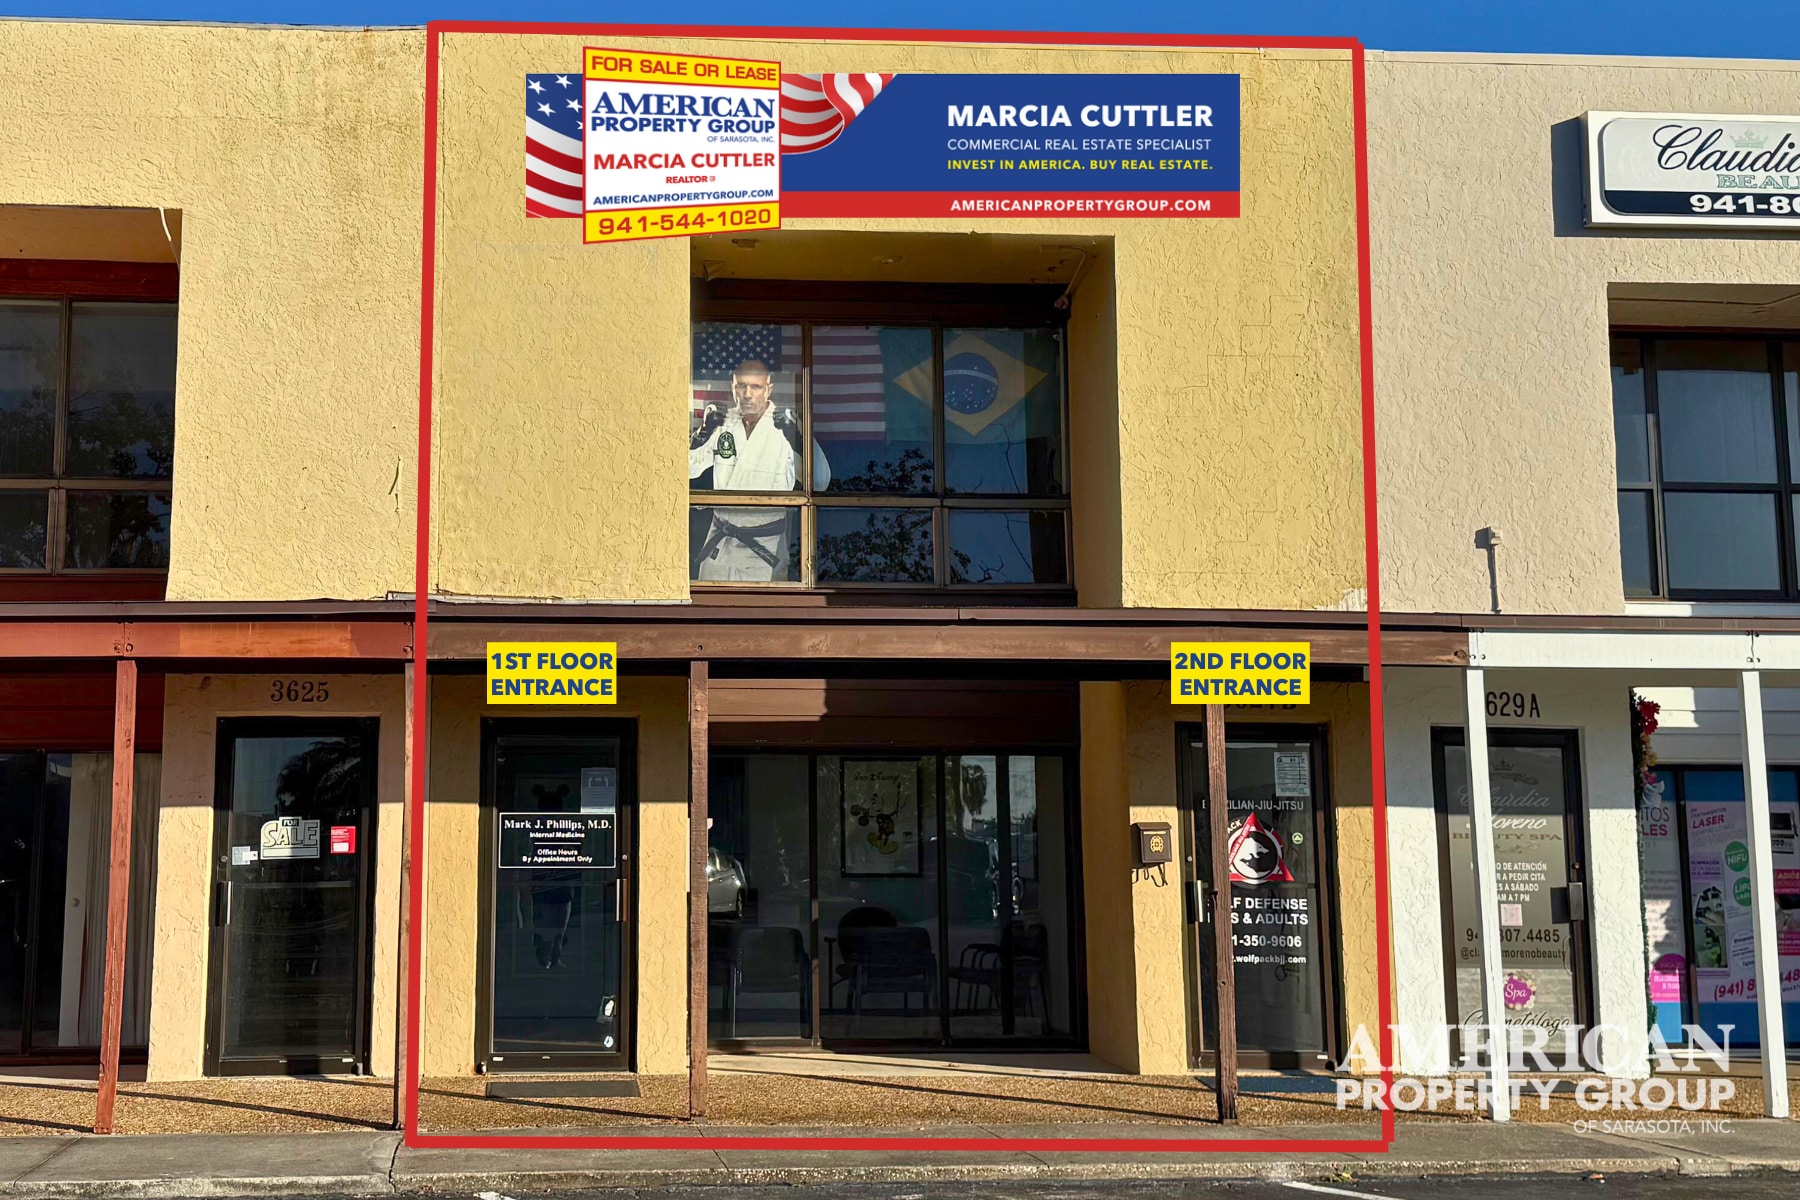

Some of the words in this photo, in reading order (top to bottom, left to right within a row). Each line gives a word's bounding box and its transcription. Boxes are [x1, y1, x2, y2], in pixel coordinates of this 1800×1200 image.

[1717, 174, 1800, 189] BEAU
[270, 679, 329, 703] 3625
[1485, 691, 1541, 718] 629A
[1202, 799, 1304, 810] ILIAN-JIU-JITSU
[504, 819, 532, 829] Mark
[535, 819, 544, 829] J.
[546, 819, 585, 831] Phillips,
[587, 819, 612, 829] M.D.
[1692, 814, 1725, 829] LASER
[263, 822, 318, 848] SALE
[537, 848, 557, 856] Office
[558, 848, 578, 856] Hours
[1727, 852, 1748, 865] HIFU
[522, 855, 532, 863] By
[533, 855, 576, 864] Appointment
[577, 855, 592, 863] Only
[1502, 862, 1513, 871] DE
[1513, 860, 1547, 871] ATENCIÓN
[1502, 873, 1508, 881] A
[1508, 872, 1529, 881] PEDIR
[1530, 872, 1546, 881] CITA
[1504, 883, 1510, 891] A
[1510, 881, 1539, 892] SÁBADO
[1245, 897, 1308, 910] DEFENSE
[1520, 893, 1530, 902] PM
[1242, 912, 1253, 924] &
[1255, 913, 1309, 925] ADULTS
[1231, 934, 1302, 948] 1-350-9606
[1466, 928, 1560, 942] 907.4485
[1232, 954, 1307, 965] .wolfpackbjj.com
[1461, 946, 1566, 961] @clmorenobeauty
[1505, 983, 1528, 1001] Spa
[1714, 979, 1744, 1002] (941)
[1463, 1009, 1572, 1037] Cetóloga
